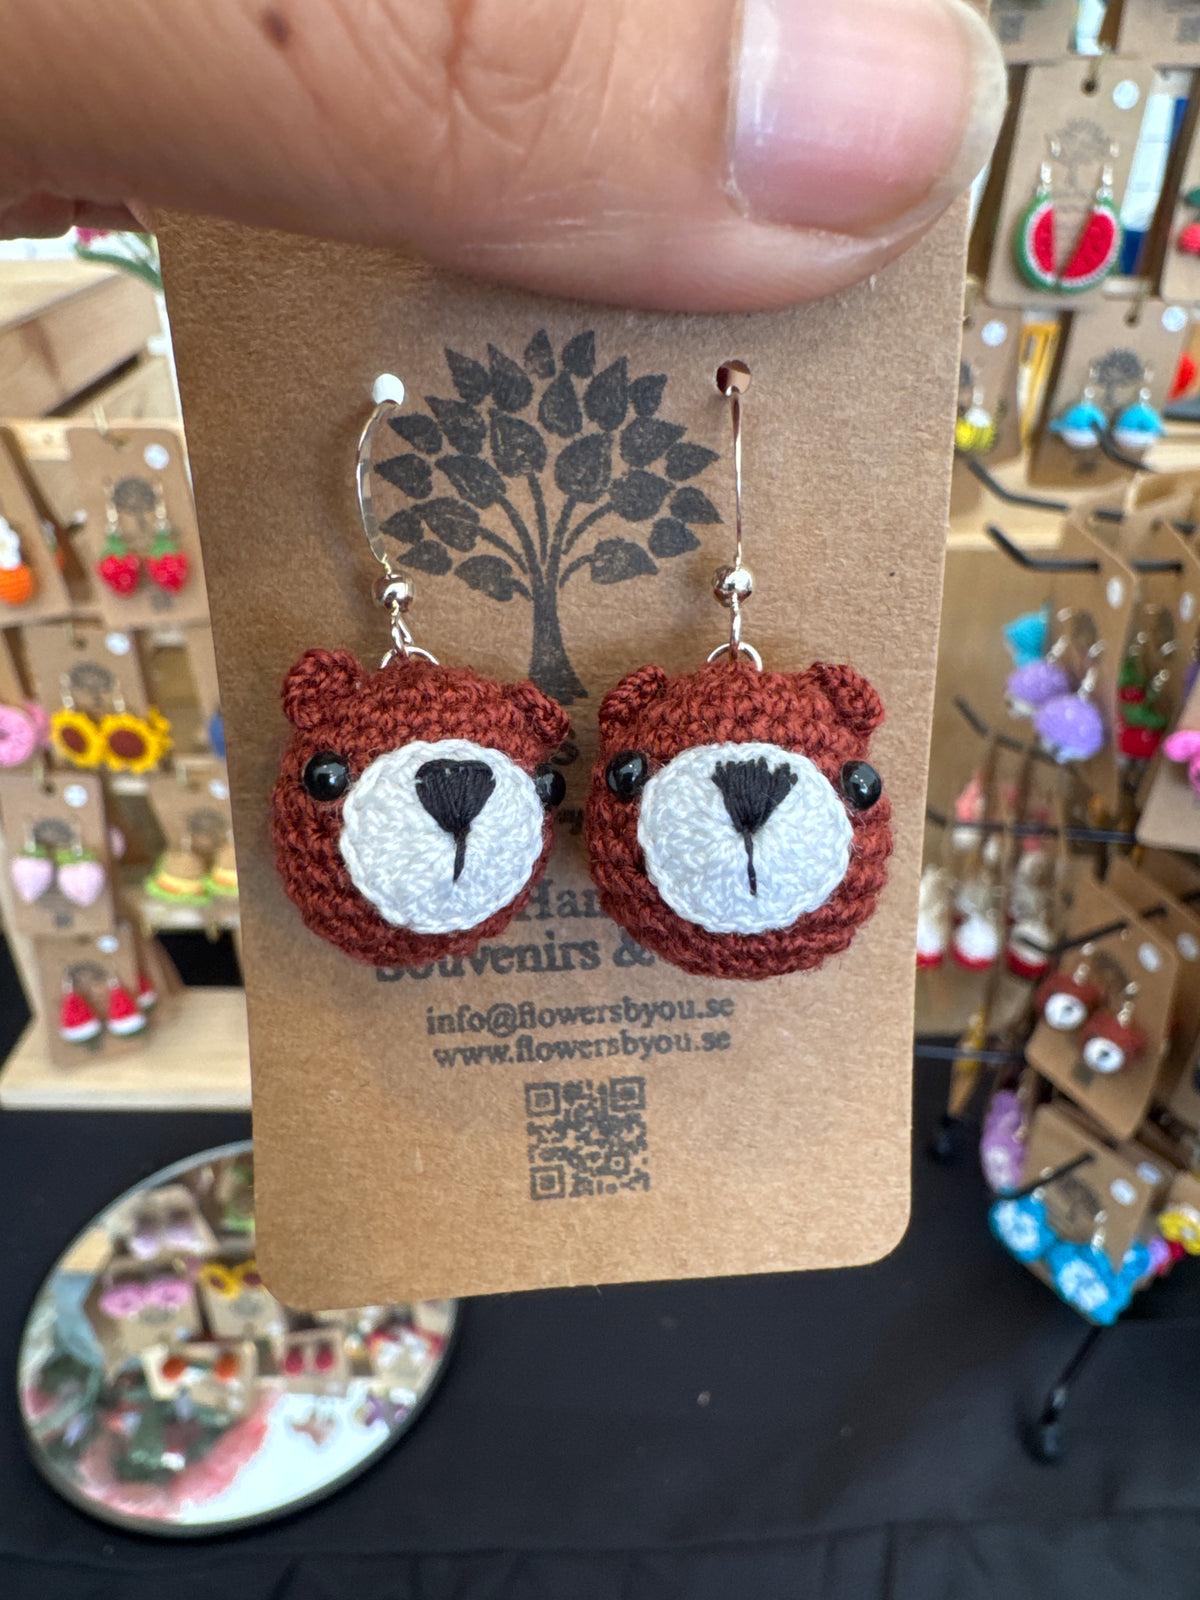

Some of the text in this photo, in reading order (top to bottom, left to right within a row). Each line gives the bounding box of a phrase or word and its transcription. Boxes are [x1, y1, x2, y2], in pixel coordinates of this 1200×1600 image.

[613, 927, 655, 967] &
[426, 996, 734, 1037] info@flowersbyou.se
[433, 1029, 731, 1067] www.flowersbyou.se
